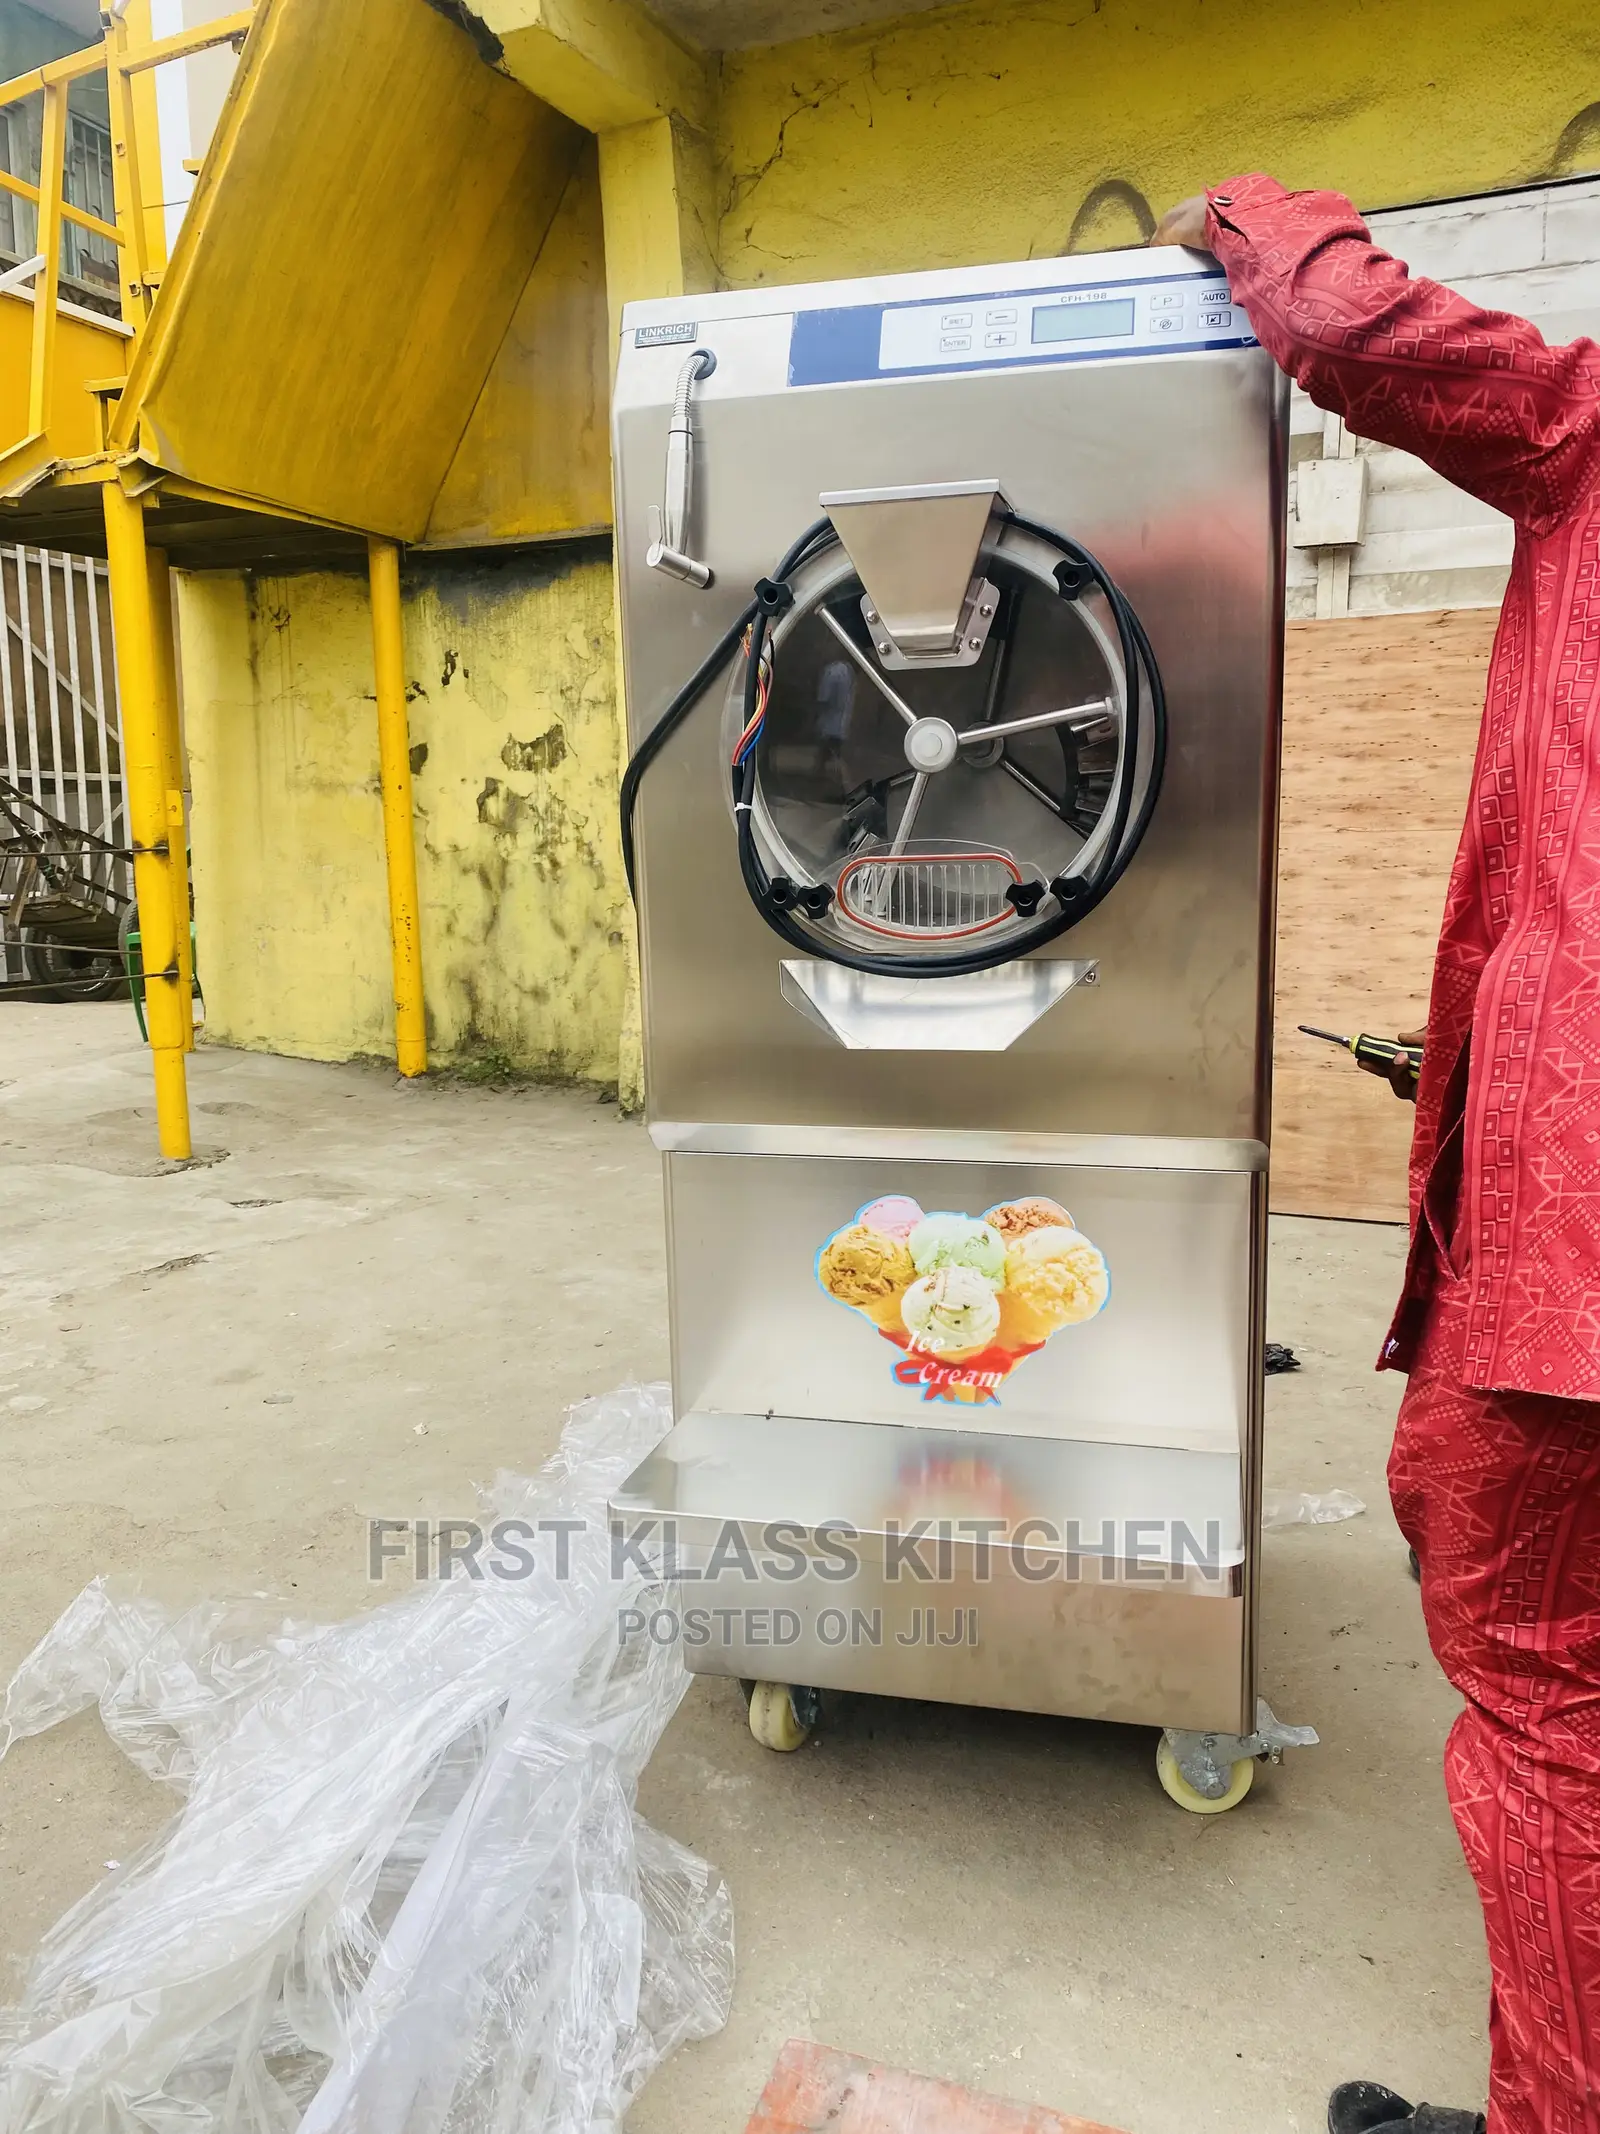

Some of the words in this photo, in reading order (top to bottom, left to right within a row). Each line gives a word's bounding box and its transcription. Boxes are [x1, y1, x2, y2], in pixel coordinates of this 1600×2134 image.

[1203, 292, 1226, 302] AUTO
[639, 323, 693, 338] LINKRICH
[905, 1329, 945, 1353] Ice
[918, 1361, 1003, 1388] Cream
